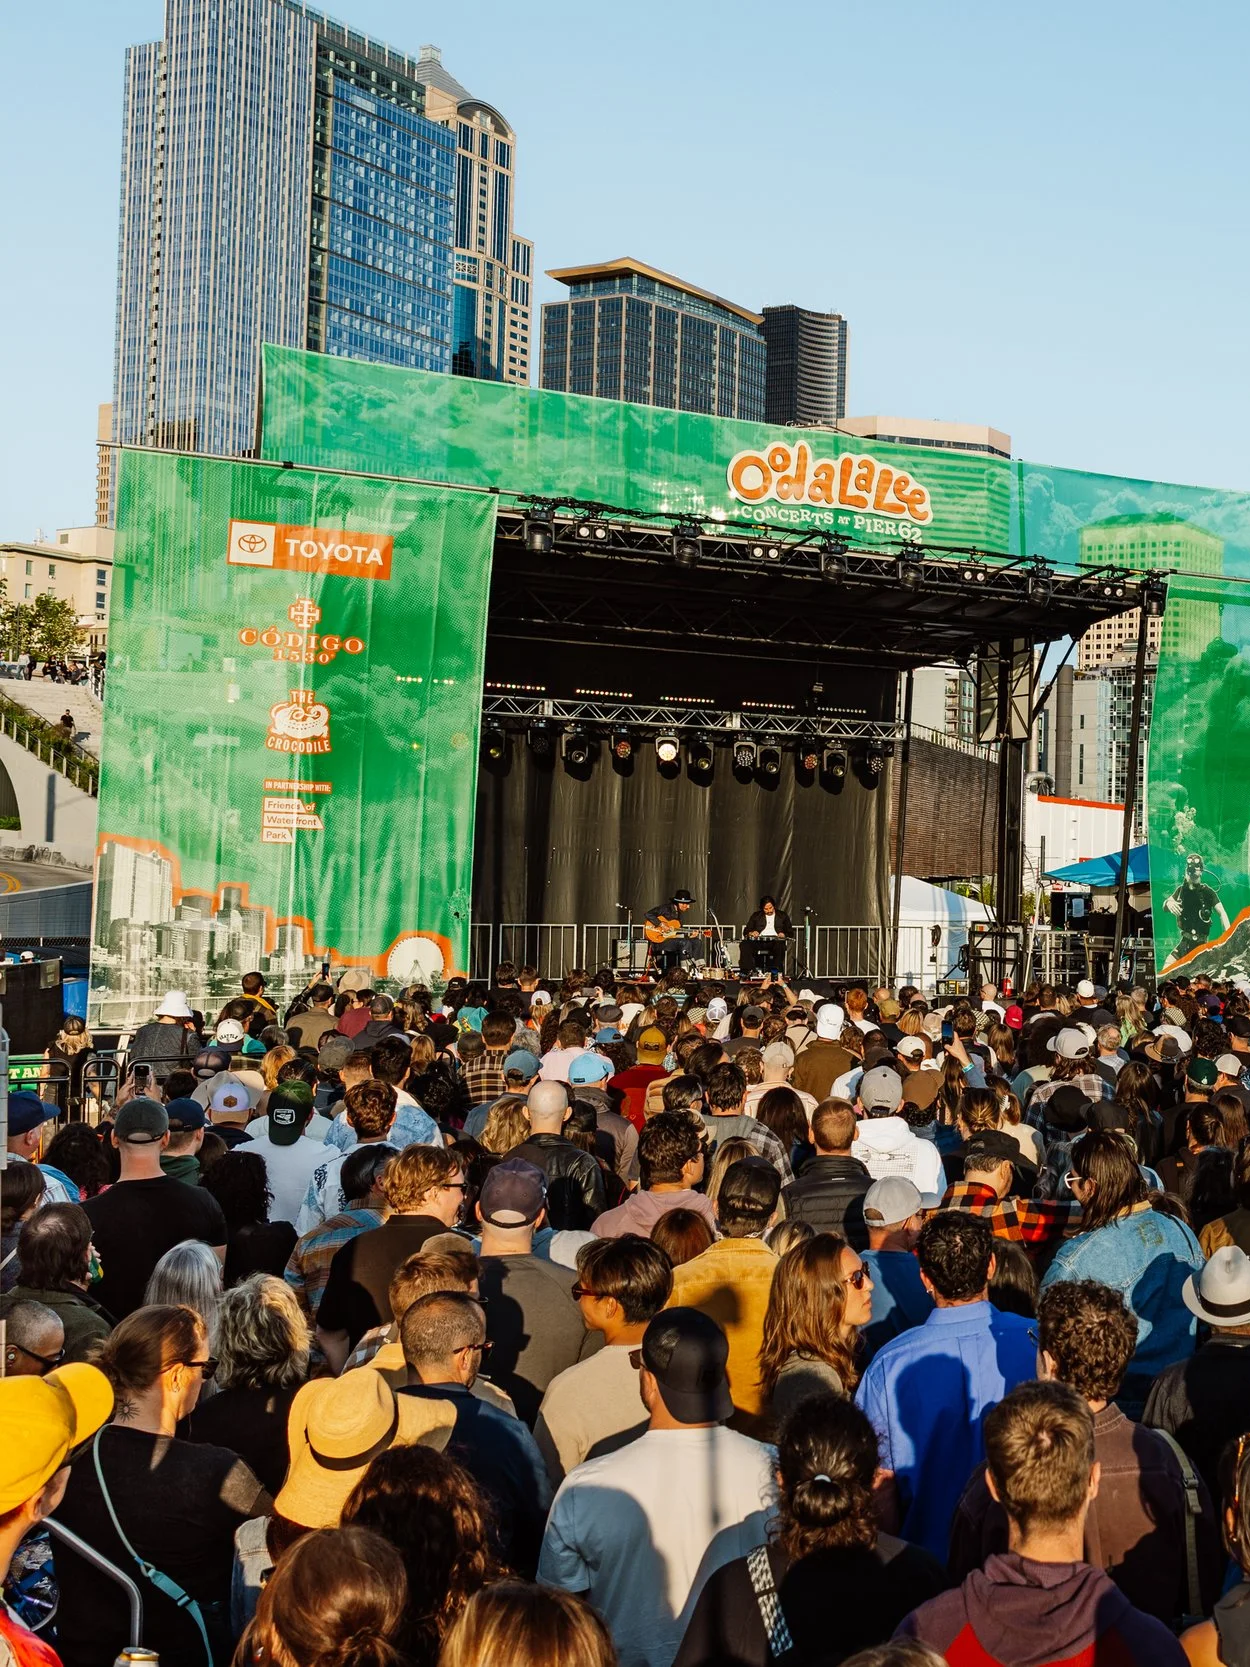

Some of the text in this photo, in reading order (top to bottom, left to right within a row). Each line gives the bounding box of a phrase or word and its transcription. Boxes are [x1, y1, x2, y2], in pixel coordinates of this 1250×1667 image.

[740, 503, 834, 525] CONCERTS
[837, 515, 850, 525] AT
[284, 538, 384, 566] TOYOTA
[240, 626, 363, 653] CÓDIGO
[291, 690, 314, 704] THE
[267, 736, 331, 753] CROCODILE
[265, 780, 273, 789] IN
[314, 783, 331, 792] WITH:
[305, 803, 316, 811] of
[266, 830, 287, 839] Park
